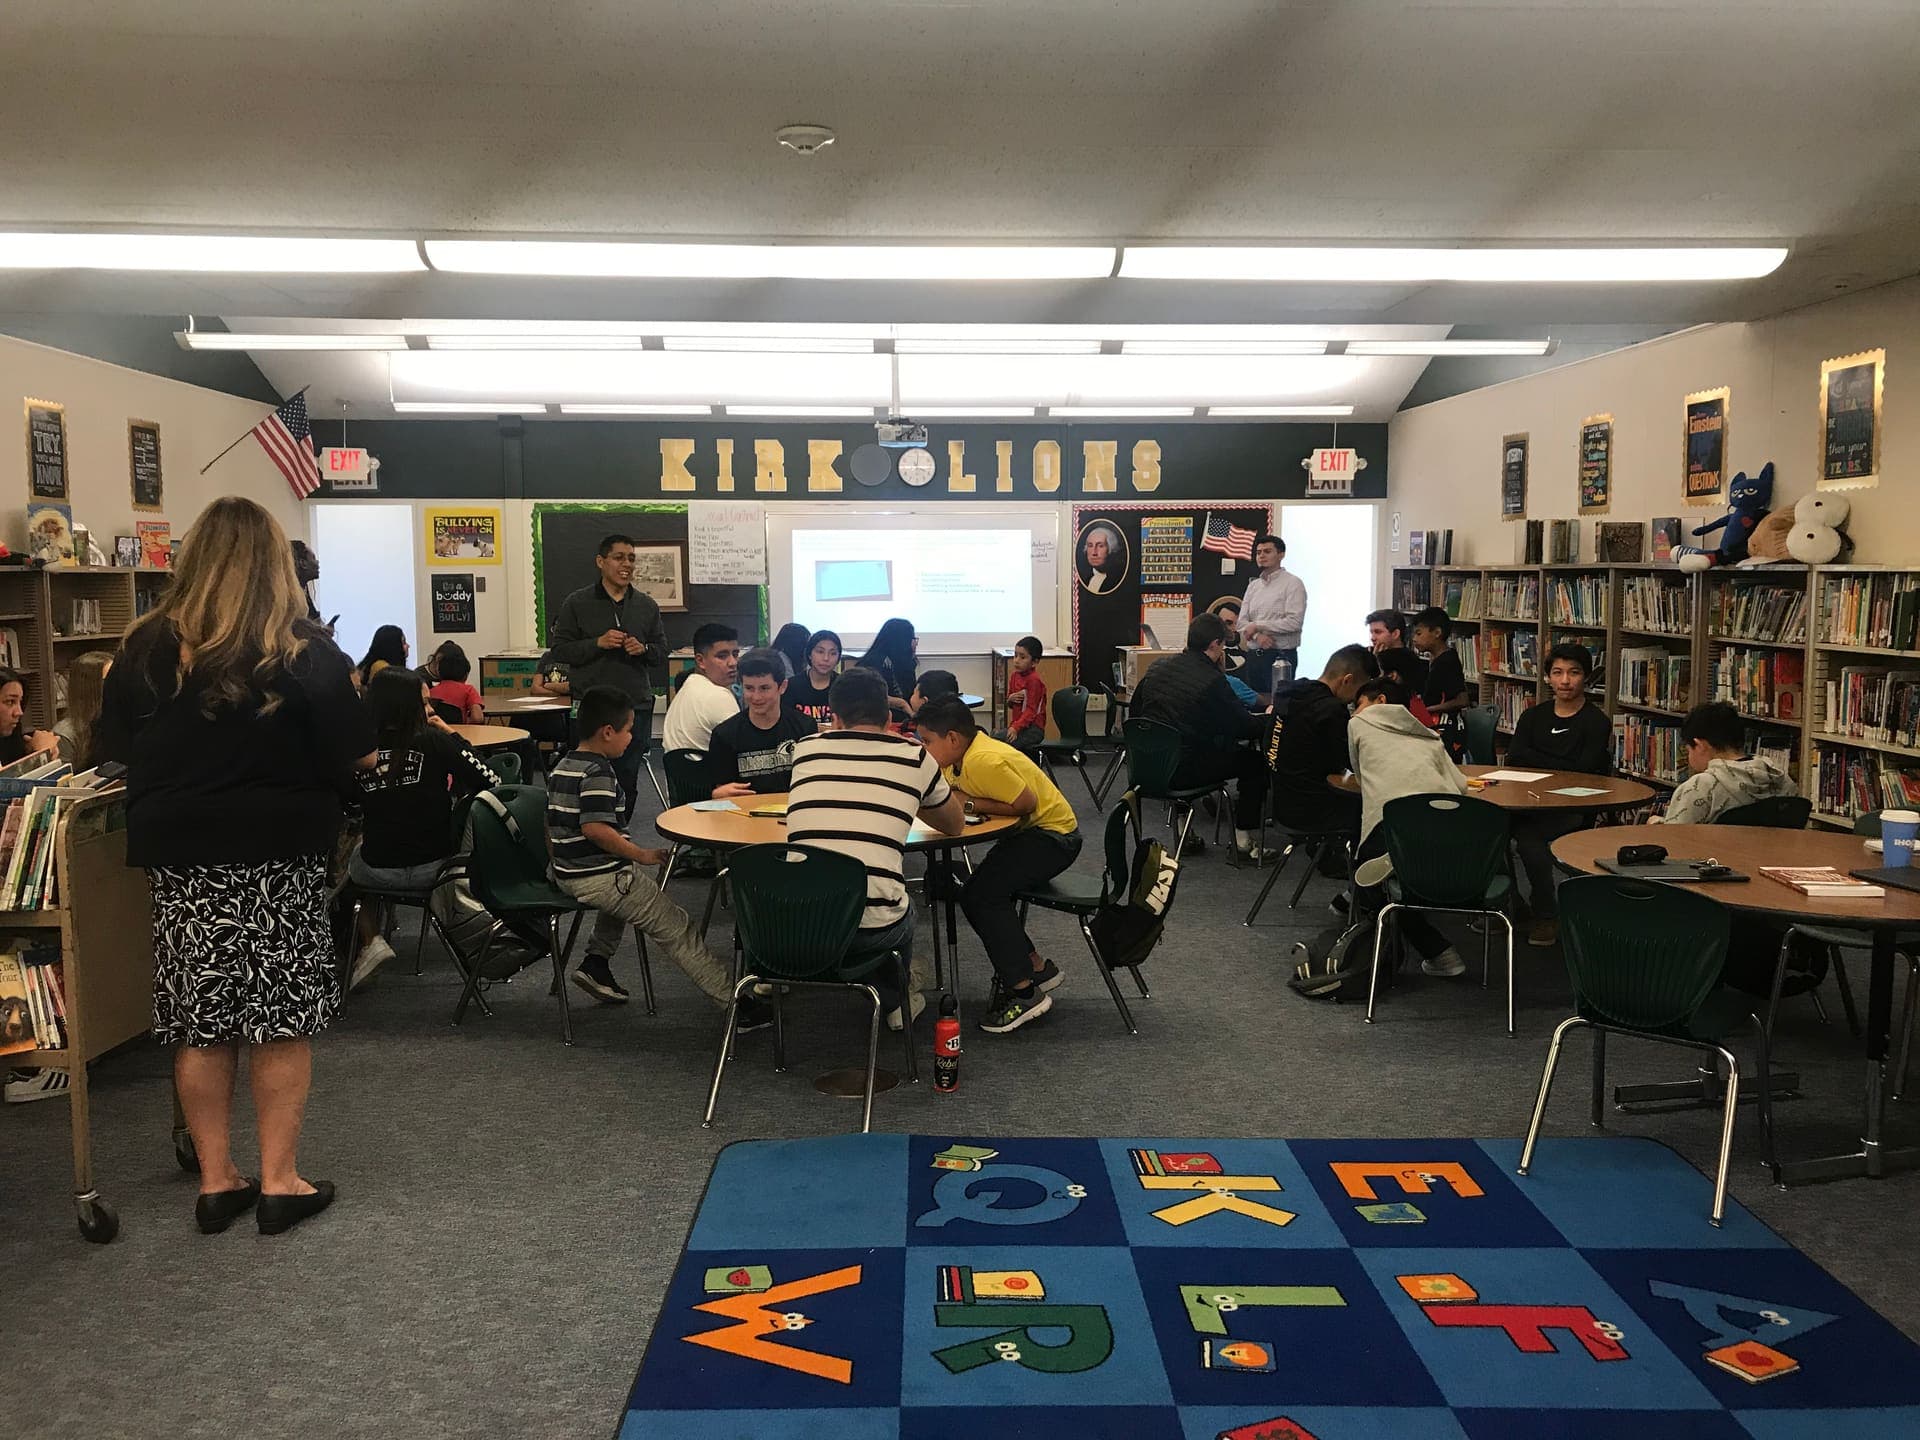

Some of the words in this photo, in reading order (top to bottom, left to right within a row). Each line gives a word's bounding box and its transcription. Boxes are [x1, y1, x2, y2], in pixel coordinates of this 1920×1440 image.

[1689, 415, 1721, 434] Einstein
[330, 450, 361, 471] EXIT
[659, 438, 843, 492] KIRK
[947, 439, 1162, 492] LIONS
[1321, 451, 1350, 471] EXIT
[1848, 442, 1867, 458] your
[1689, 470, 1720, 491] QUESTIONS
[436, 517, 494, 527] BULLYING
[436, 590, 472, 602] buddy
[936, 1057, 960, 1070] Rebel
[914, 1163, 1083, 1227] Q
[1329, 1161, 1486, 1200] E
[1138, 1175, 1299, 1227] K
[1179, 1285, 1348, 1335] L
[1647, 1278, 1845, 1350] A
[931, 1304, 1115, 1374] R
[1419, 1304, 1632, 1362] F
